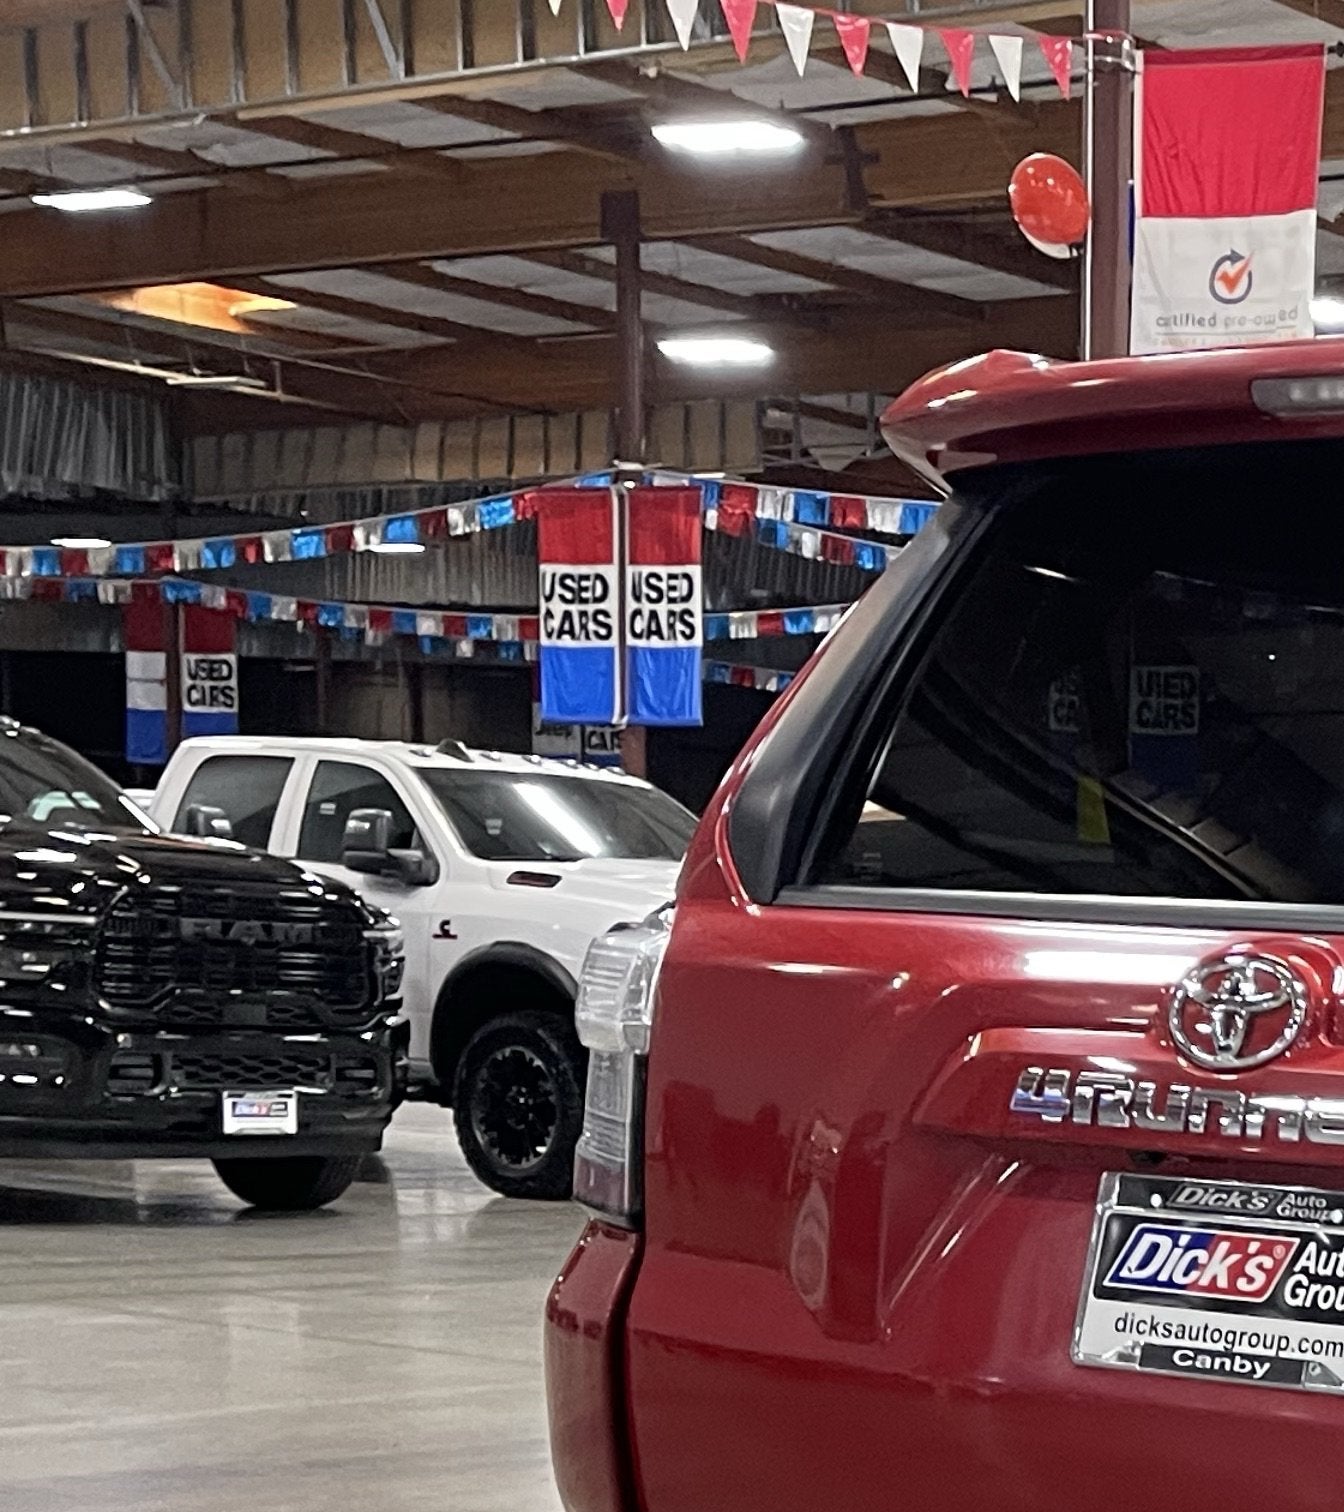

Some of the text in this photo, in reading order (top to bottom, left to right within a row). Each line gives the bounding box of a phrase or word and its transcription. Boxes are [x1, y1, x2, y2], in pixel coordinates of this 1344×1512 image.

[541, 571, 609, 604] USED
[631, 571, 694, 604] USED
[543, 608, 612, 641] CARS
[629, 607, 696, 641] CARS
[186, 659, 233, 681] USED
[180, 917, 313, 945] RAM
[1281, 1193, 1327, 1208] Auto
[1114, 1312, 1344, 1358] dicksautogroup.com
[1172, 1350, 1271, 1379] Canby
